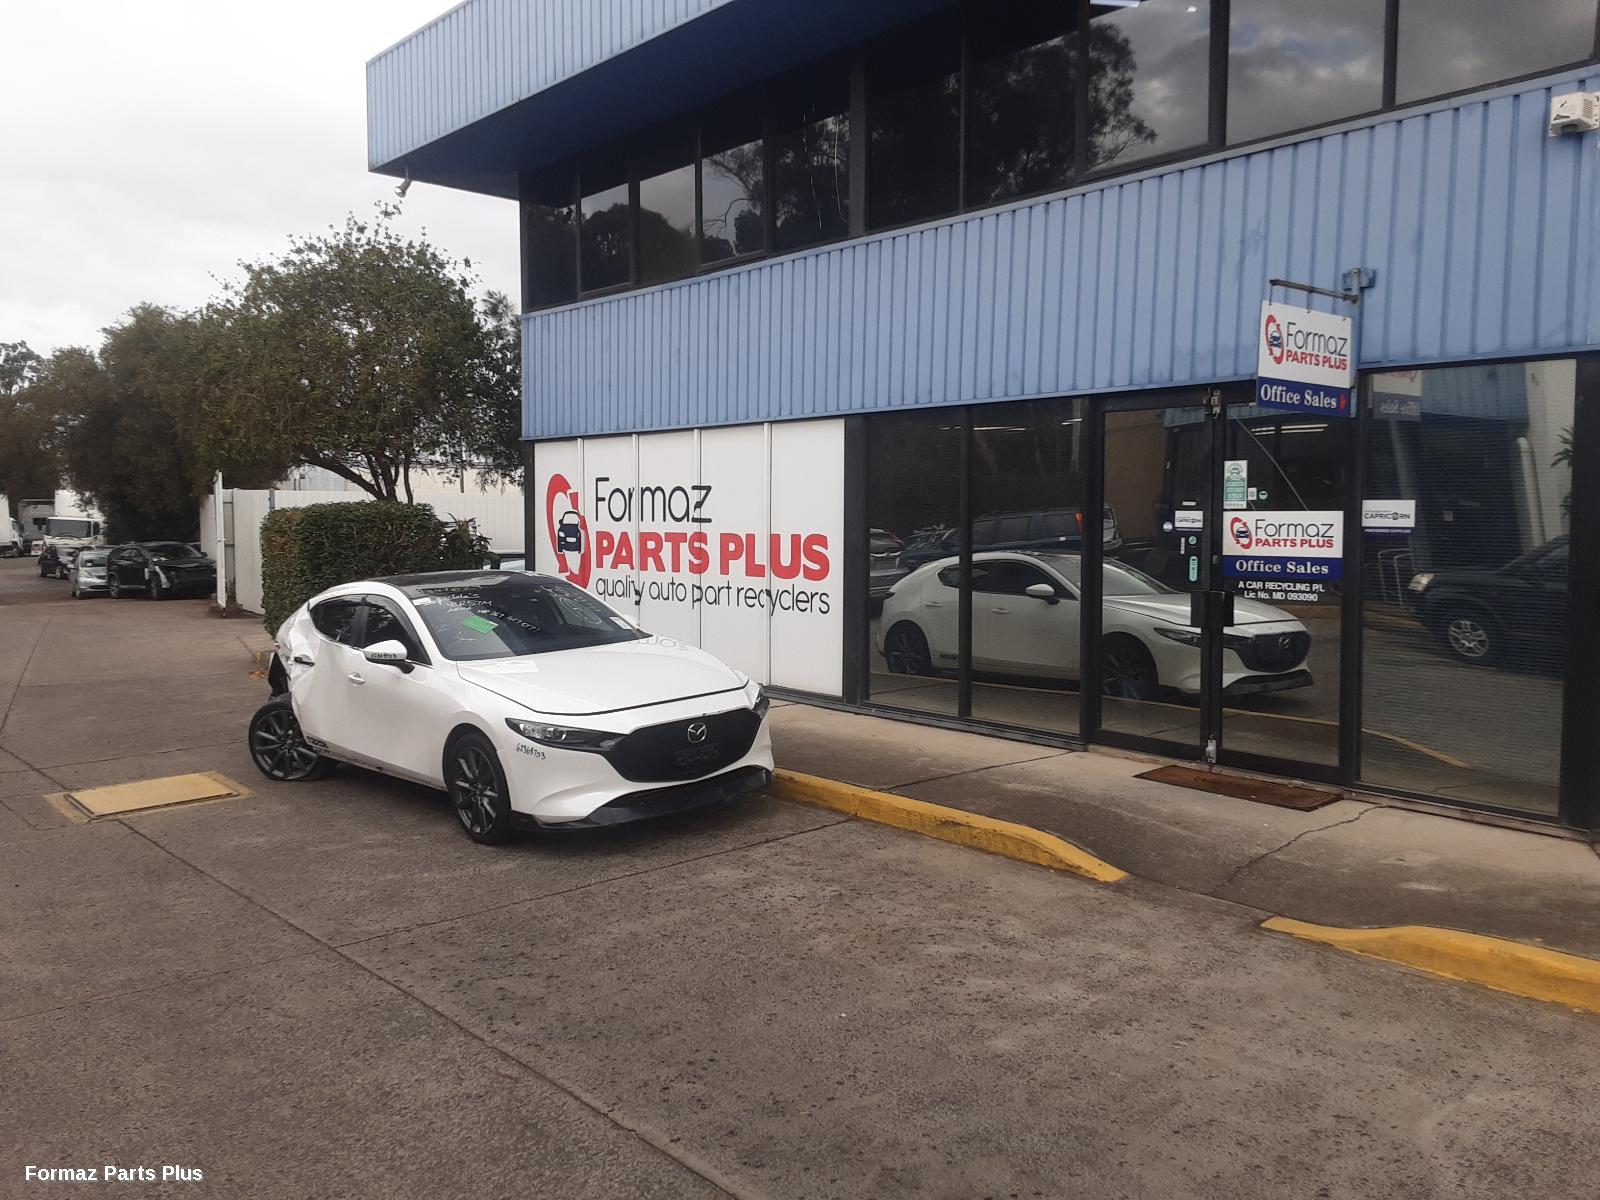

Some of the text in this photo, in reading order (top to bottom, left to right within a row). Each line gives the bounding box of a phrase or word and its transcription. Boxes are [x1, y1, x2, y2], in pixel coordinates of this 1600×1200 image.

[1286, 321, 1348, 357] Formaz
[1286, 349, 1348, 371] PARTS PLUS
[1260, 384, 1337, 409] Office Sales
[595, 477, 712, 523] Formaz
[1255, 518, 1334, 538] Formaz
[1255, 538, 1334, 549] PARTS PLUS
[595, 530, 831, 581] PARTS PLUS
[1236, 559, 1329, 575] Office Sales
[649, 577, 686, 602] auto
[692, 582, 733, 610] part
[736, 585, 830, 616] recyclers
[1238, 581, 1245, 589] A
[1246, 581, 1263, 589] CAR
[1265, 582, 1311, 591] RECYCLING
[1244, 590, 1318, 601] Lic No. MD 093090
